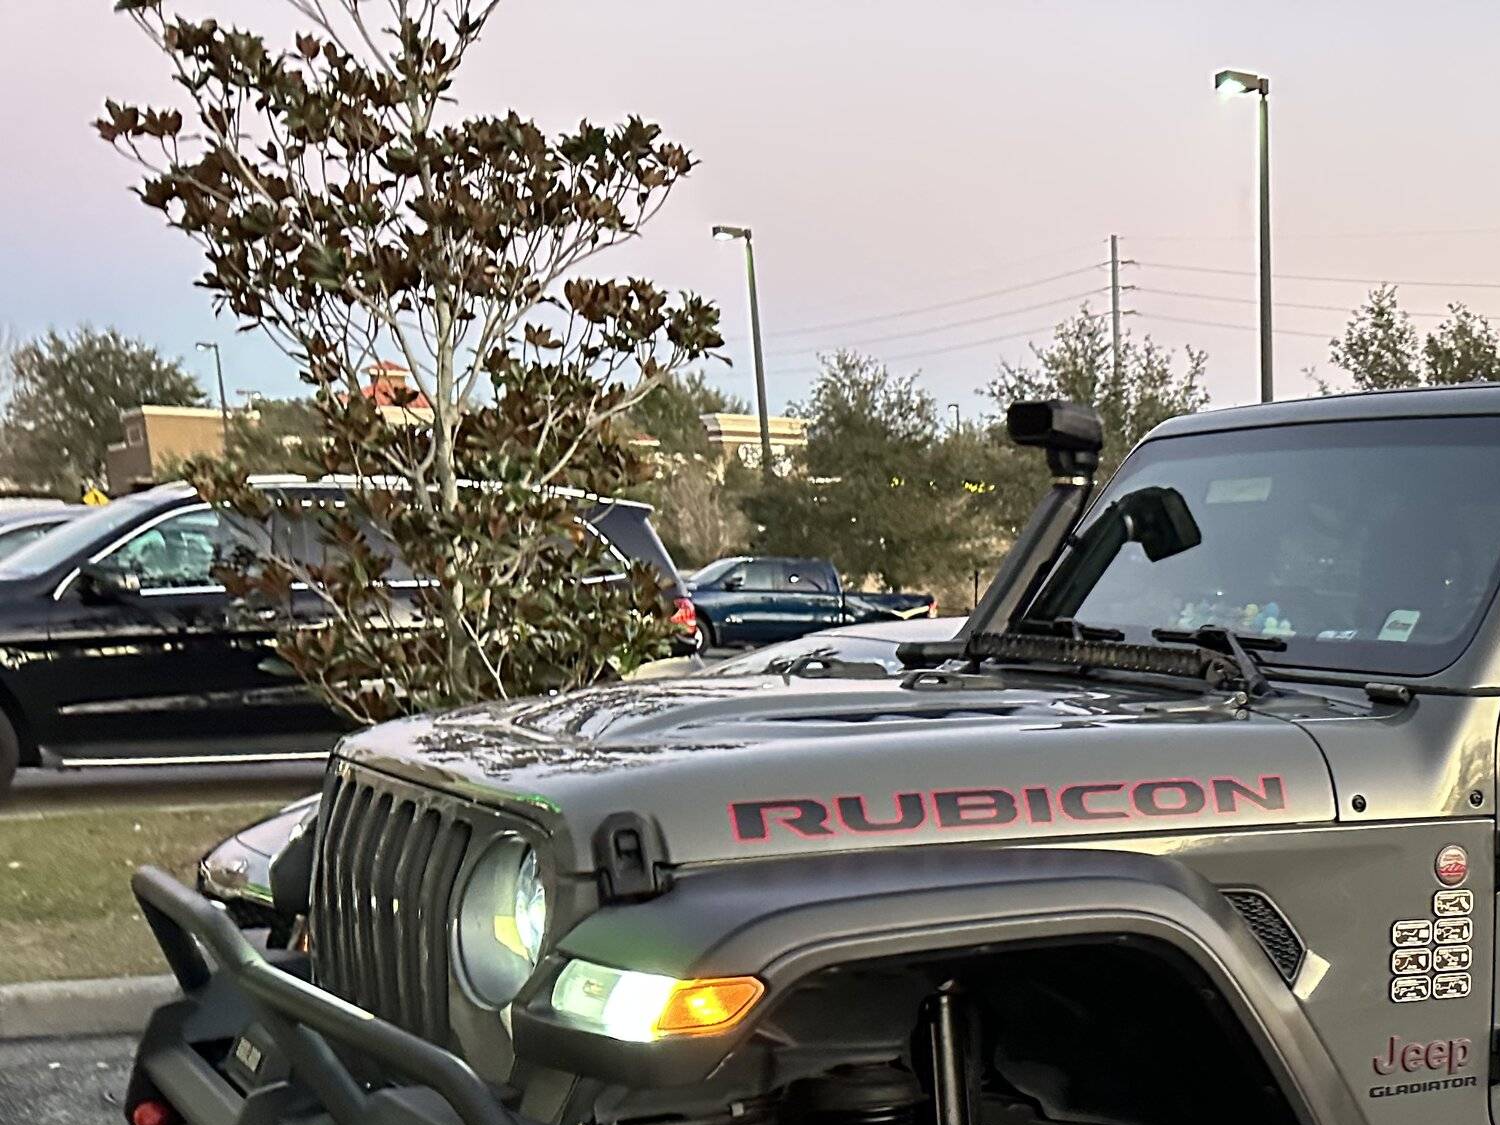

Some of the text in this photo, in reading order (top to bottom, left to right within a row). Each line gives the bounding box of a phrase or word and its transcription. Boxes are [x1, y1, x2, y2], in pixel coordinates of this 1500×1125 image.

[727, 775, 1286, 843] RUBICON
[1372, 1035, 1472, 1076] Jeep
[1368, 1076, 1478, 1099] GLADIATOR
